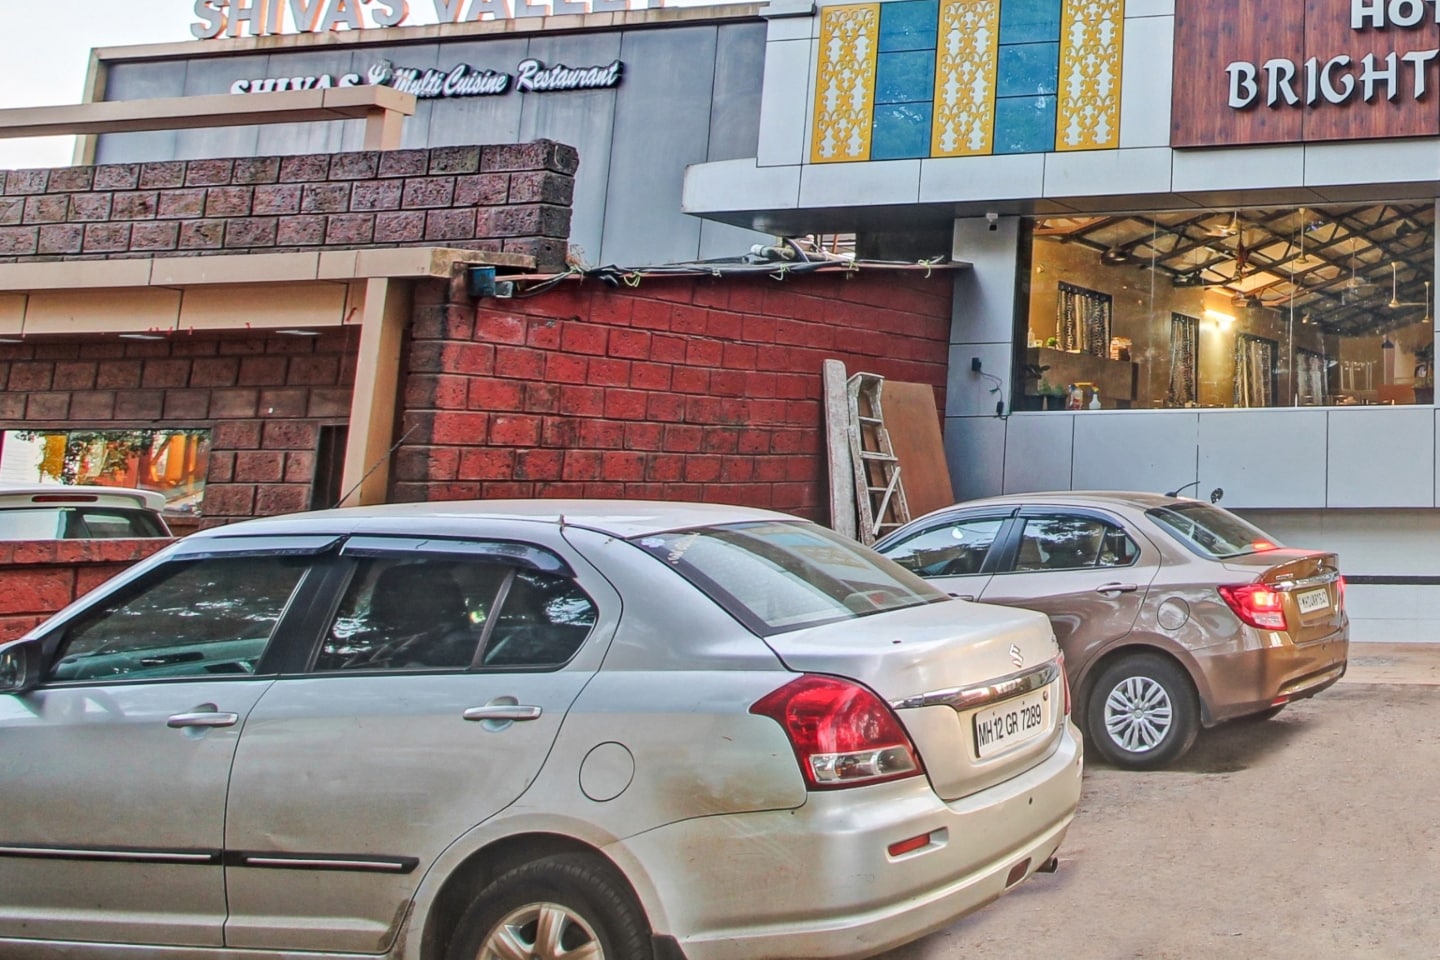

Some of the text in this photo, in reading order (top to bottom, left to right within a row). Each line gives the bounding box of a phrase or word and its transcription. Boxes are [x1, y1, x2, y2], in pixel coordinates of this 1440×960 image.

[443, 64, 508, 96] Cuisine
[516, 59, 620, 92] Restaurant
[1224, 48, 1440, 109] BRIGHT
[979, 704, 1042, 747] MH 12 GR 7289
